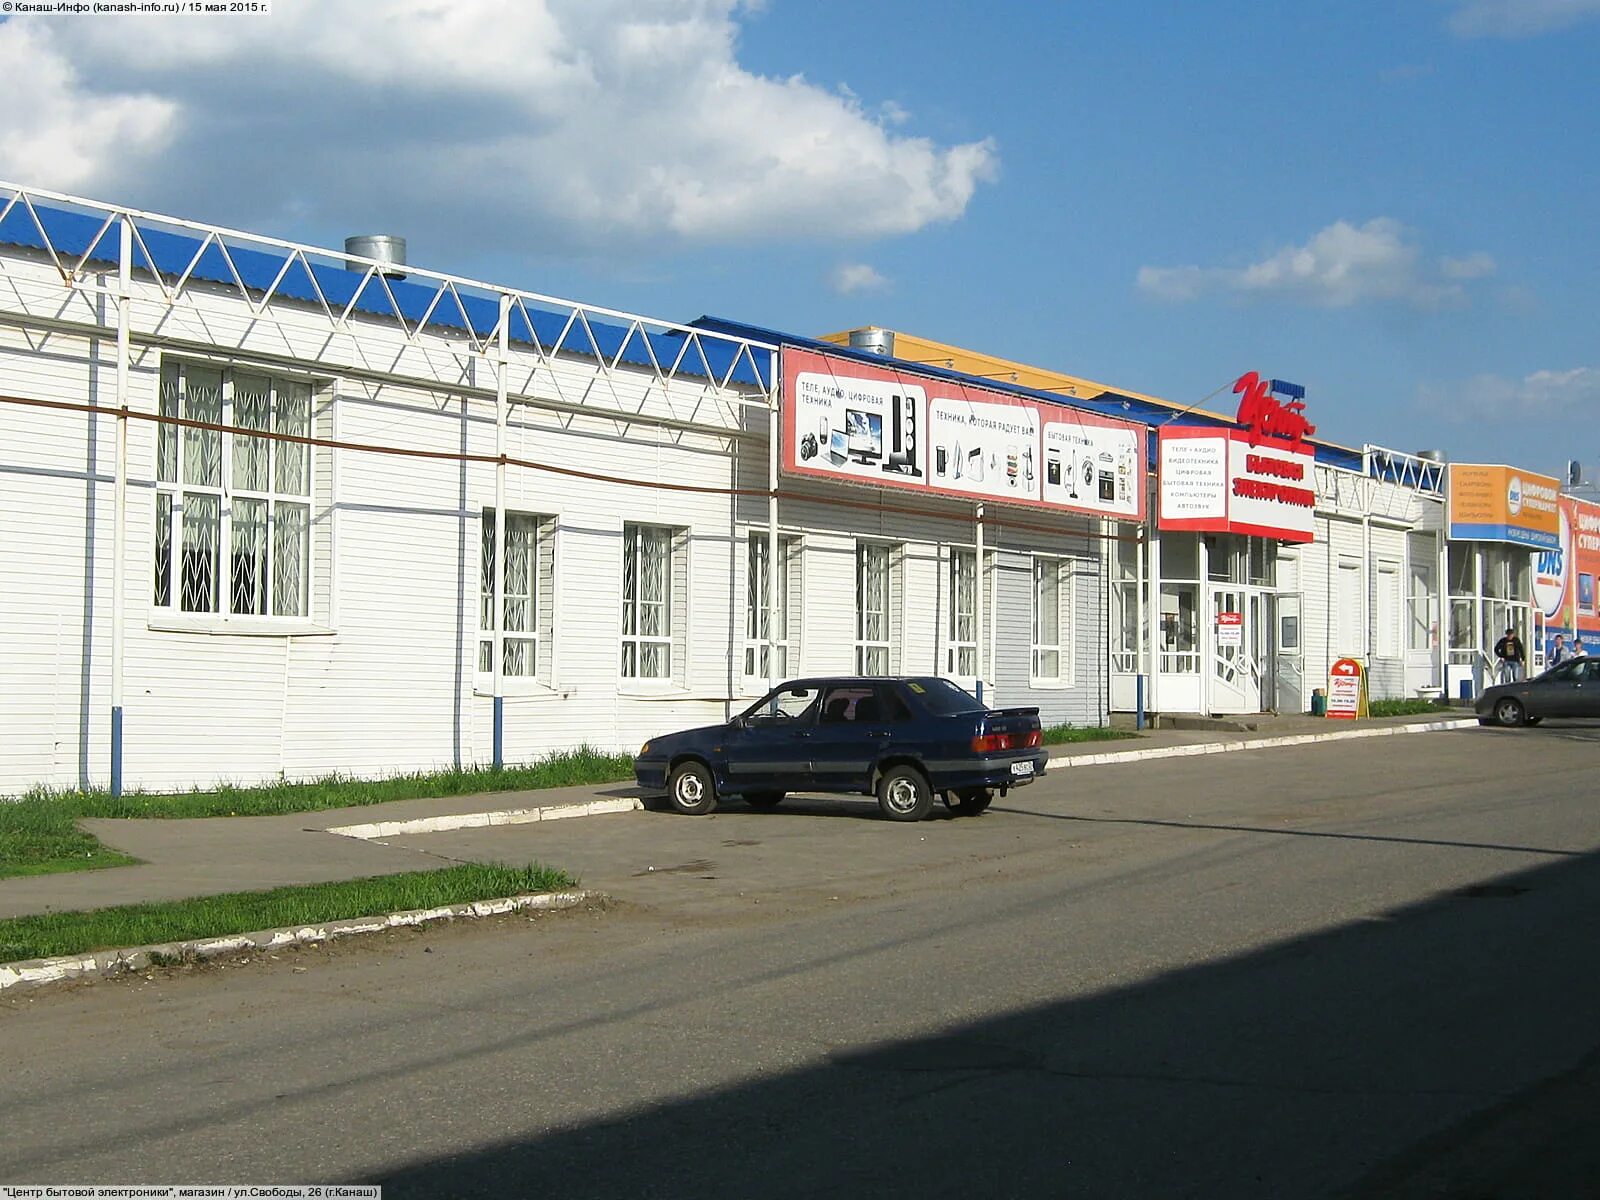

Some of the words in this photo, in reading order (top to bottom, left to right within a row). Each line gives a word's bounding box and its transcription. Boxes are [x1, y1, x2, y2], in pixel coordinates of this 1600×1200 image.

[801, 381, 820, 395] ТЕЛЕ,
[848, 391, 884, 407] ЦИФРОВАЯ
[802, 394, 833, 408] ТЕХНИКА
[936, 410, 967, 426] ТЕХНИКА,
[998, 421, 1021, 436] РАДУЕТ
[1021, 425, 1035, 438] ВА
[1047, 430, 1072, 443] БЫТОВАЯ
[1171, 446, 1188, 454] ТЕЛЕ
[1175, 468, 1212, 477] ЦИФРОВАЯ
[1162, 480, 1194, 488] БЫТОВАЯ
[1195, 480, 1225, 488] ТЕХНИКА
[1170, 491, 1217, 499] КОМПЬЮТЕРЫ
[1177, 503, 1210, 511] АВТОЗВУК
[1537, 551, 1563, 577] DNS
